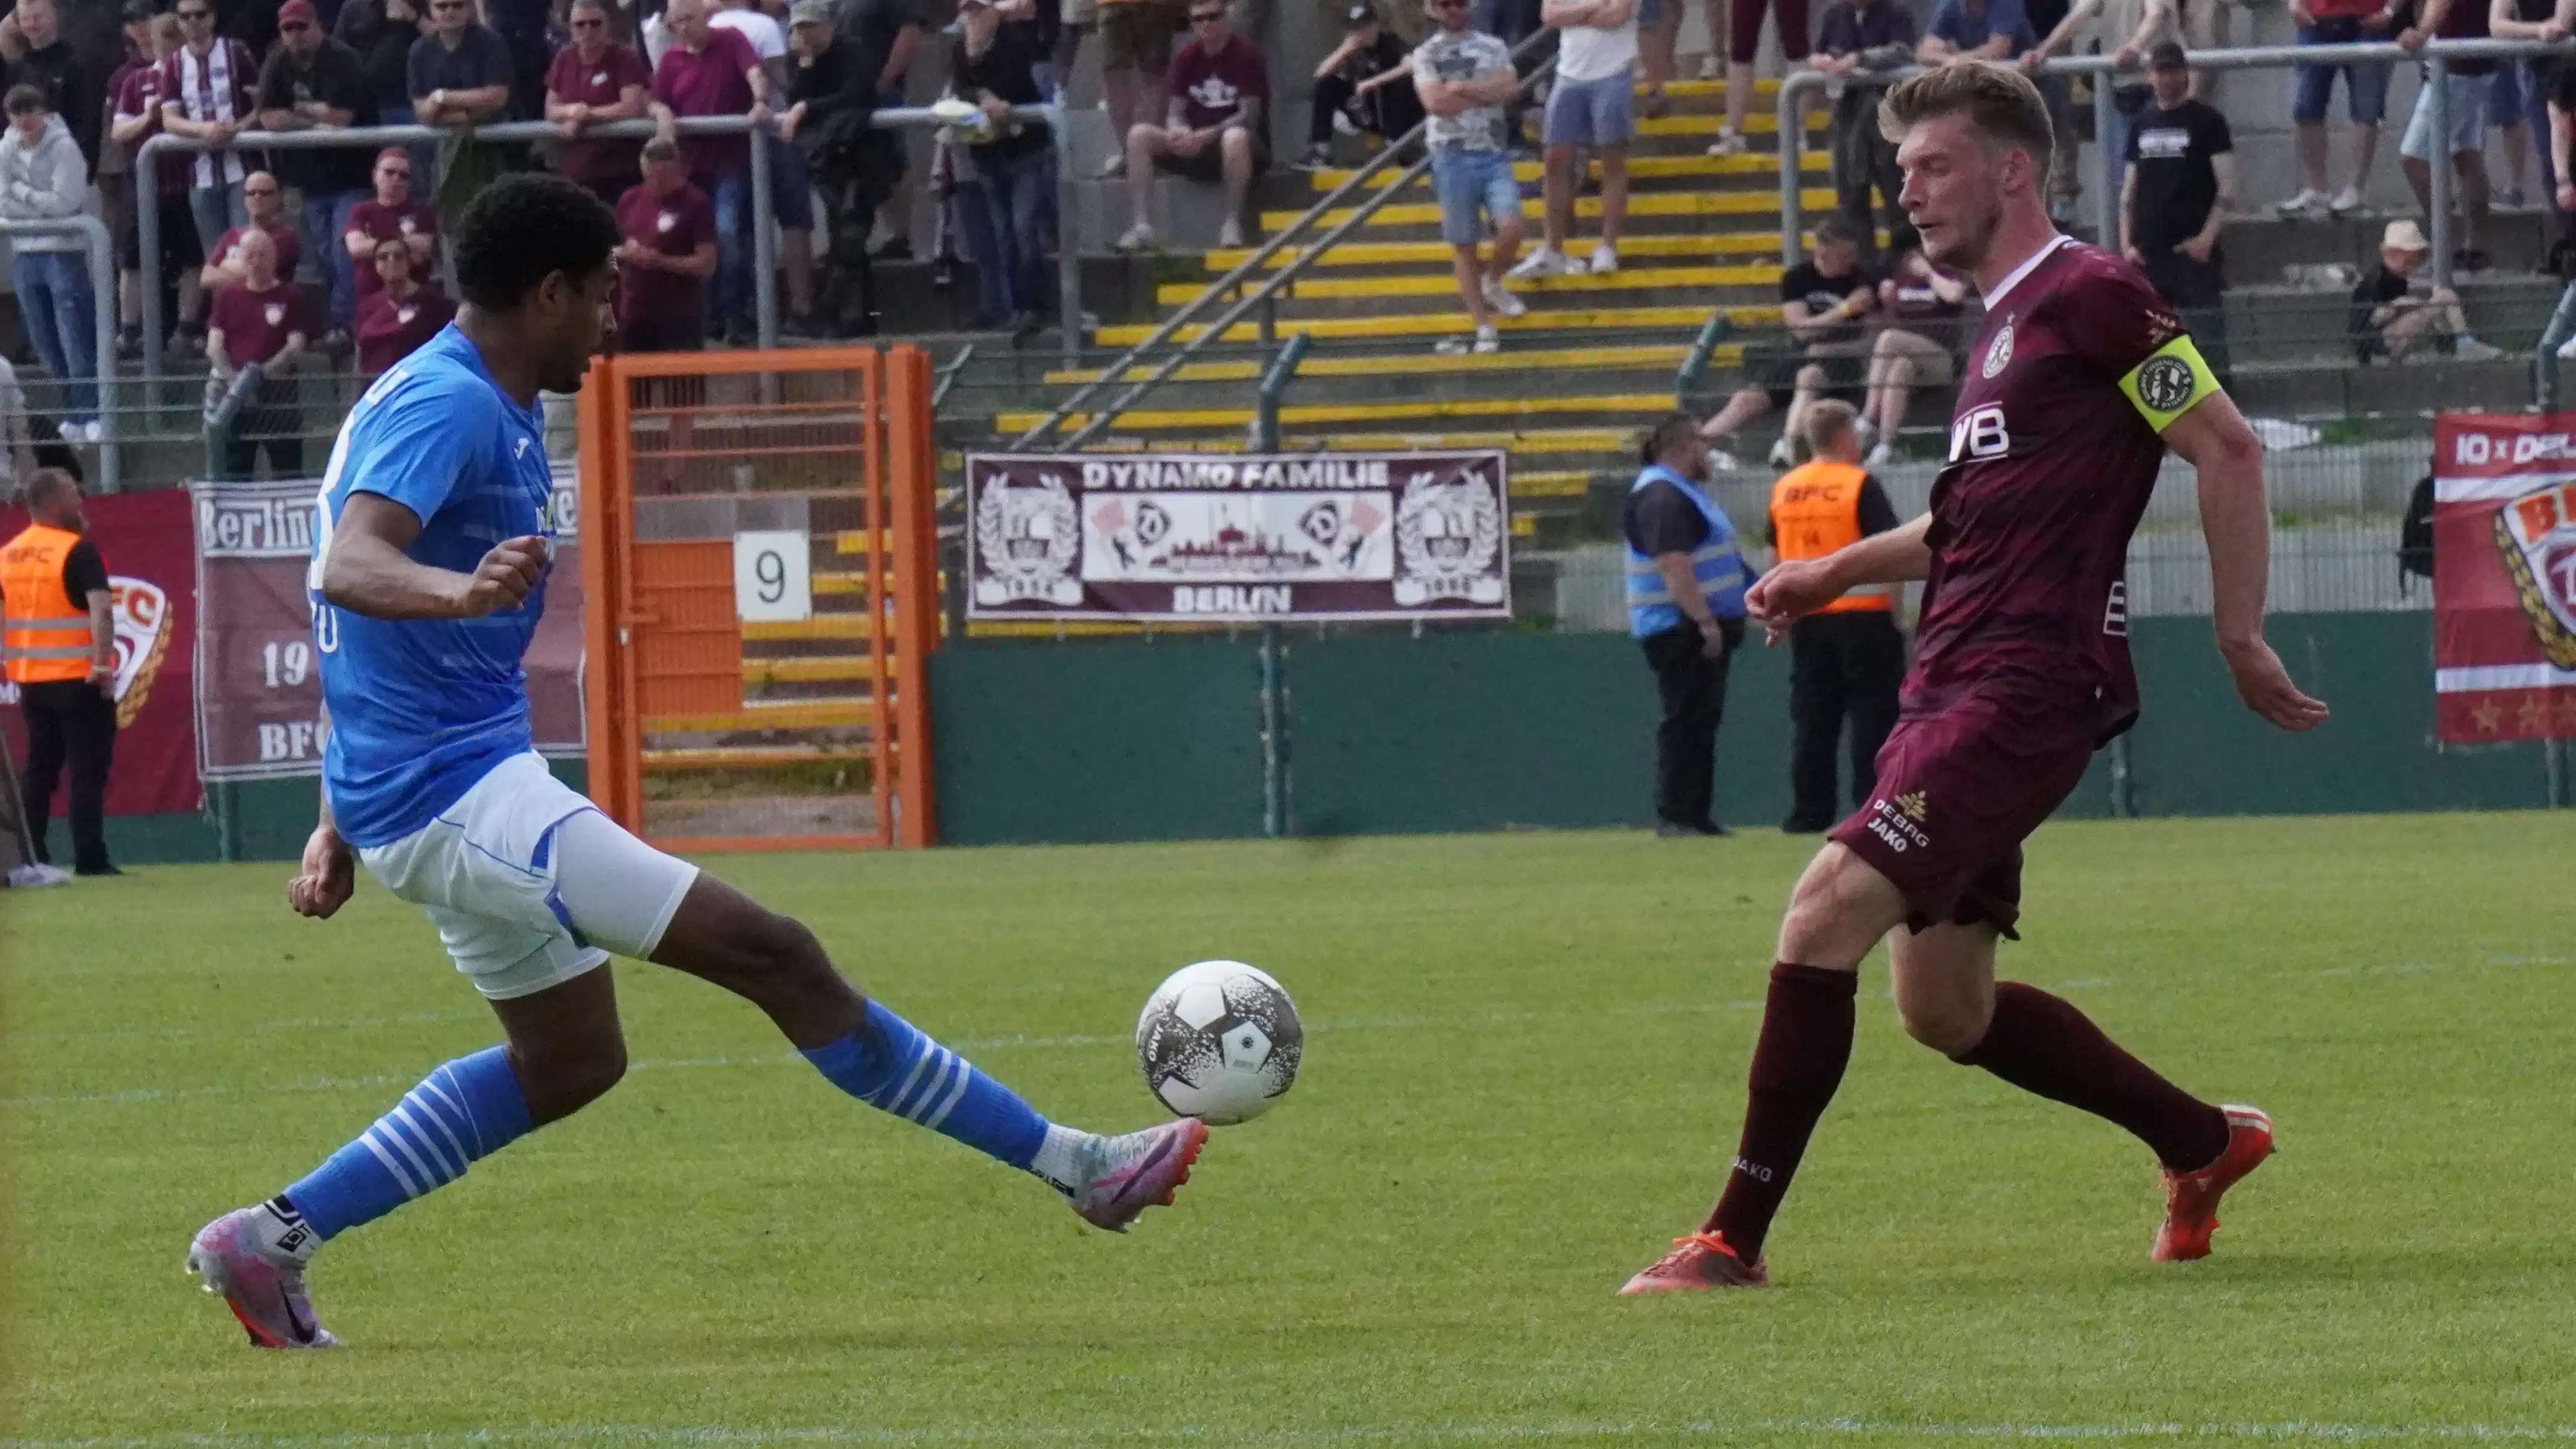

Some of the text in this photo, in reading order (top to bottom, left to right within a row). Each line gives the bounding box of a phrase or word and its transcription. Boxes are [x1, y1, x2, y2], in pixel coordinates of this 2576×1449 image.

[1082, 460, 1388, 488] DYNAMO FAMILIE
[200, 498, 315, 549] Berlin
[756, 549, 785, 605] 9
[1173, 585, 1292, 613] BERLIN
[1867, 817, 1907, 853] JAKO
[1148, 1023, 1164, 1062] JAKO
[1733, 1154, 1772, 1182] JAKO
